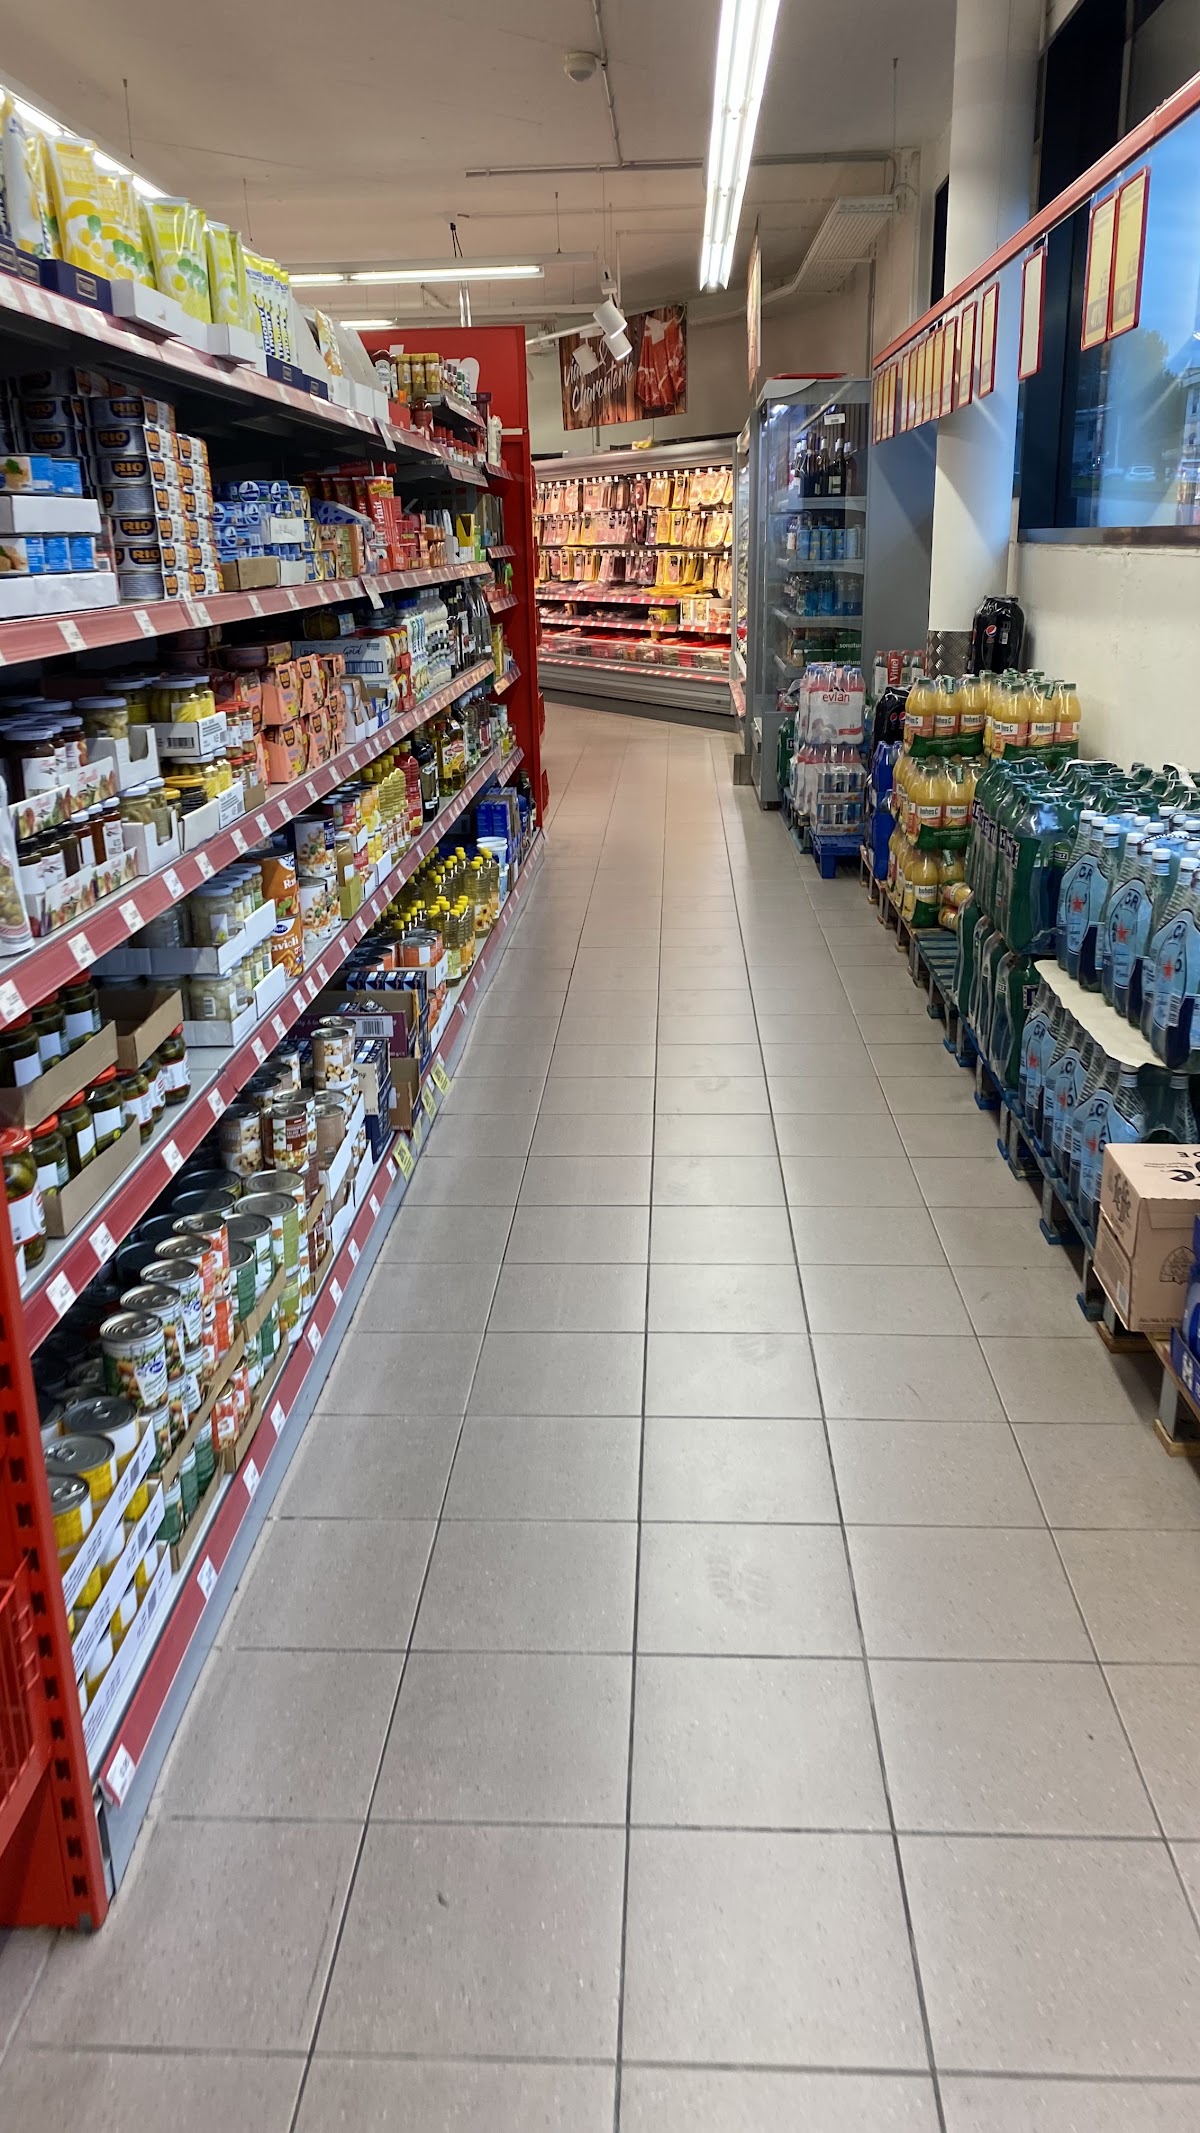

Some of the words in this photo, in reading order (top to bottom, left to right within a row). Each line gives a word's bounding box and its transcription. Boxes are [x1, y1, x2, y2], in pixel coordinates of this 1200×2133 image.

[572, 356, 635, 412] Charcuterie
[113, 402, 142, 413] RIO
[114, 462, 144, 472] RIO
[373, 500, 385, 524] rfait
[122, 521, 152, 530] RIO
[132, 550, 160, 560] RIO
[888, 658, 900, 682] Vittel
[822, 691, 850, 703] evian
[919, 807, 935, 815] hohes
[271, 935, 299, 952] avioli
